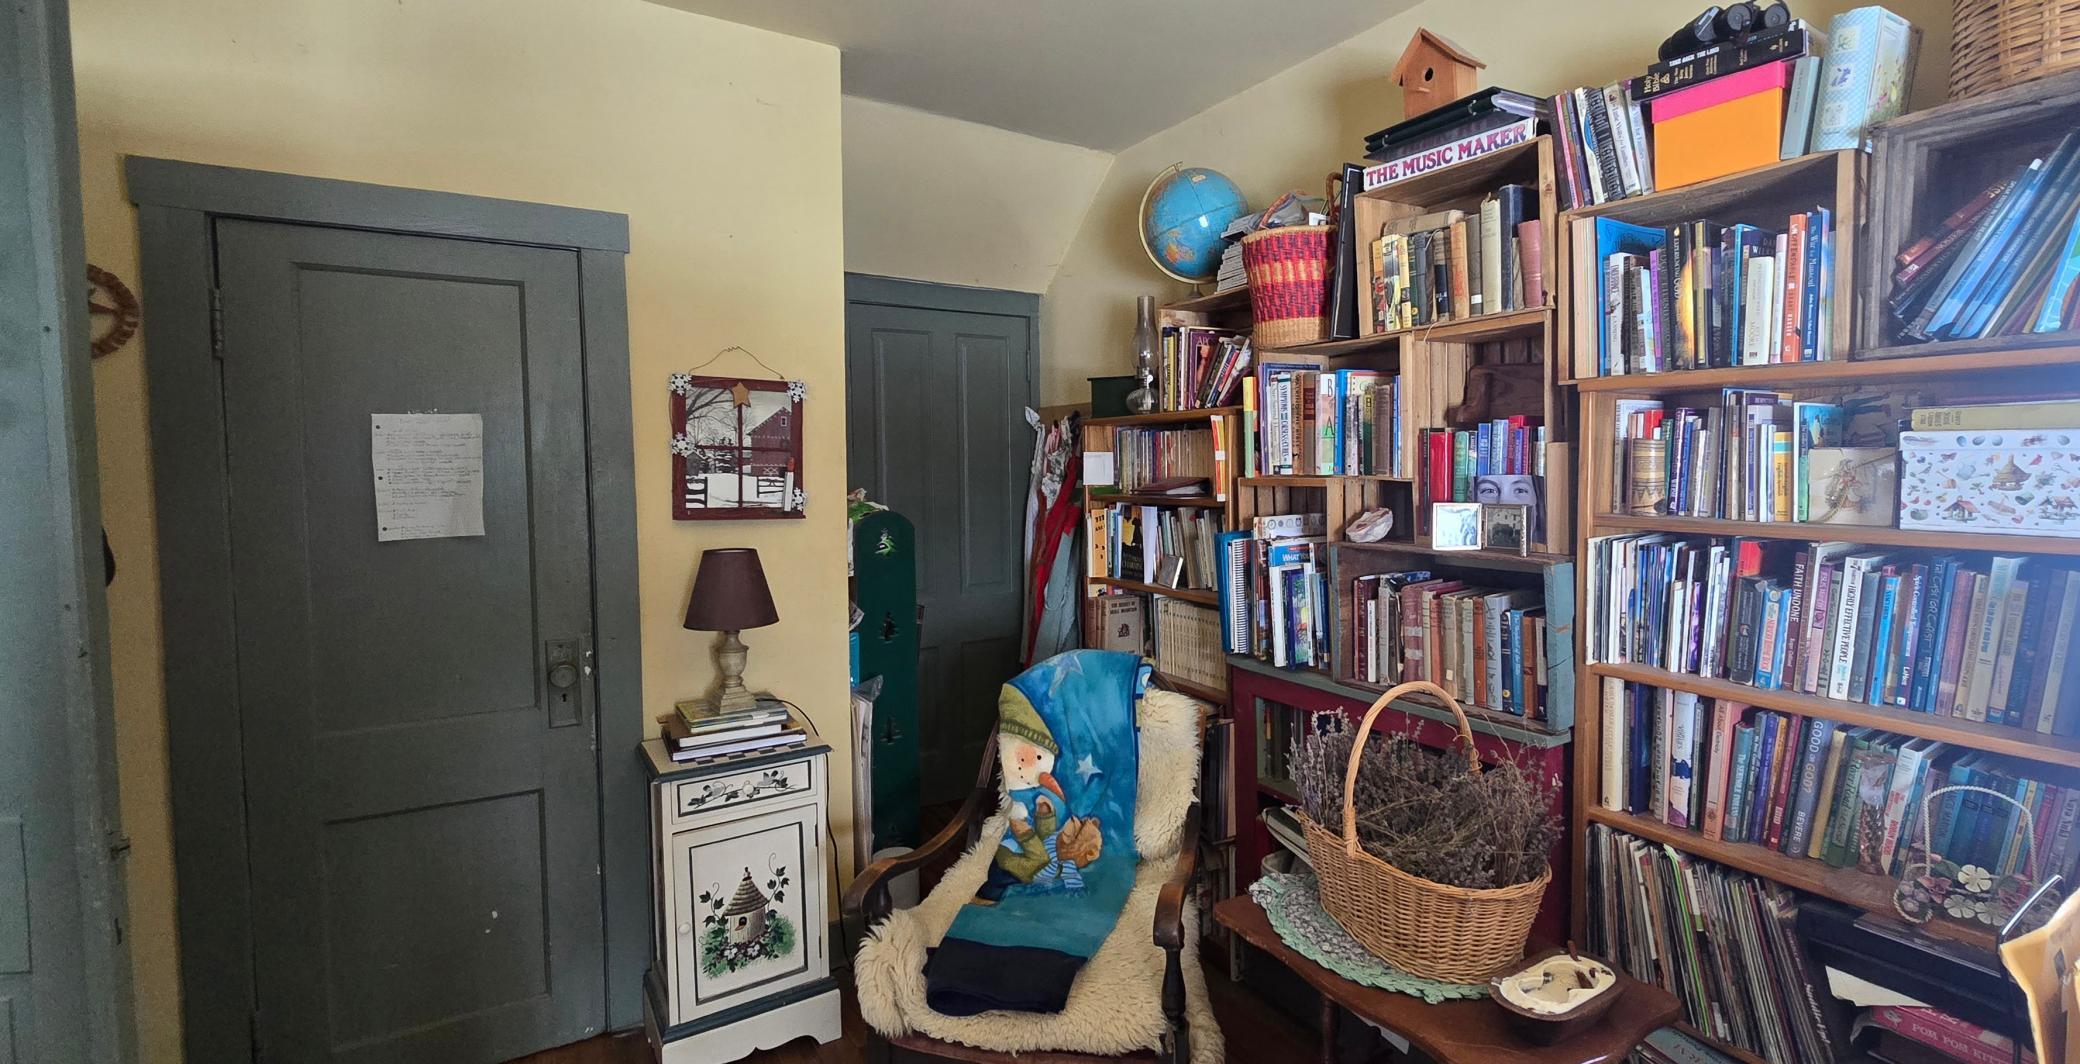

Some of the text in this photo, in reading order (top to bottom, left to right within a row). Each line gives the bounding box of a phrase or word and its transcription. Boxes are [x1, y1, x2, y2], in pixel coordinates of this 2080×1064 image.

[1643, 73, 1653, 94] Holy
[1652, 71, 1661, 93] Bible
[1366, 123, 1527, 187] THE MUSIC MAKER
[1810, 234, 1818, 248] War
[1611, 264, 1620, 293] ENDURANCE
[1808, 258, 1817, 288] Mansoul
[1673, 278, 1682, 299] GOD
[1280, 385, 1288, 412] SYMPTOMS
[1282, 553, 1299, 561] WHAT
[1793, 563, 1804, 587] FAITH
[1789, 588, 1802, 623] UNDONE
[1845, 585, 1857, 607] HIGHLY
[1929, 597, 1939, 613] FOR
[1841, 607, 1855, 640] EFFECTIVE
[1839, 640, 1850, 664] PEOPLE
[1716, 714, 1725, 731] About
[1714, 731, 1723, 754] Electricity
[1809, 720, 1824, 753] GOOD
[1737, 754, 1746, 763] The
[1802, 763, 1816, 793] GOD?
[1841, 759, 1862, 809] River Road
[1793, 811, 1806, 842] BEVERE
[1912, 1023, 1937, 1042] POM
[1943, 1034, 1968, 1053] POM
